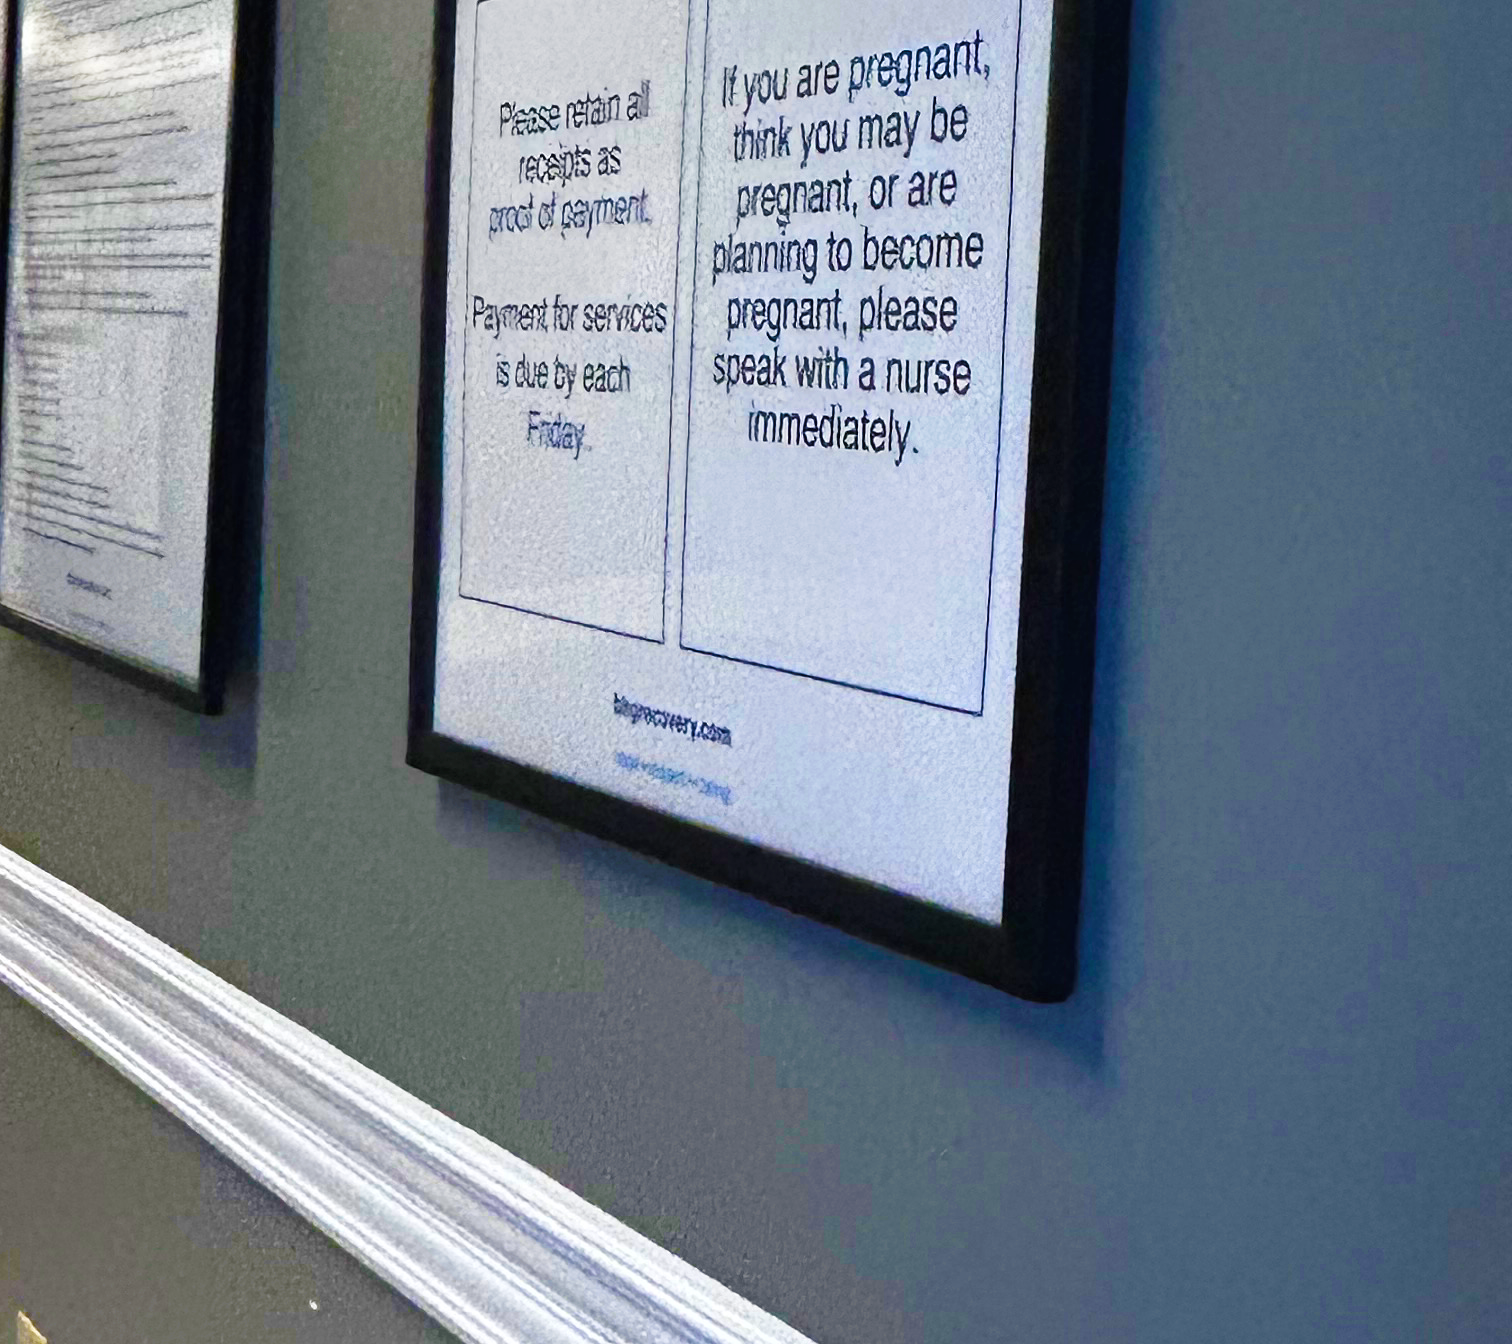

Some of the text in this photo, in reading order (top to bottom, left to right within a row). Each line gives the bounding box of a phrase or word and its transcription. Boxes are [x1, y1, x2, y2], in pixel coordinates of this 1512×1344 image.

[723, 29, 991, 115] If you are pregnant,
[499, 79, 651, 138] Please retain all
[733, 95, 968, 168] think you may be
[518, 142, 622, 187] receipts as
[736, 167, 958, 231] pregnant, or are
[712, 221, 984, 285] planning to become
[472, 292, 667, 339] Payment for services
[727, 284, 958, 342] pregnant, please
[496, 352, 631, 399] is due by each
[712, 344, 972, 396] speak with a nurse
[747, 400, 920, 467] immediately.
